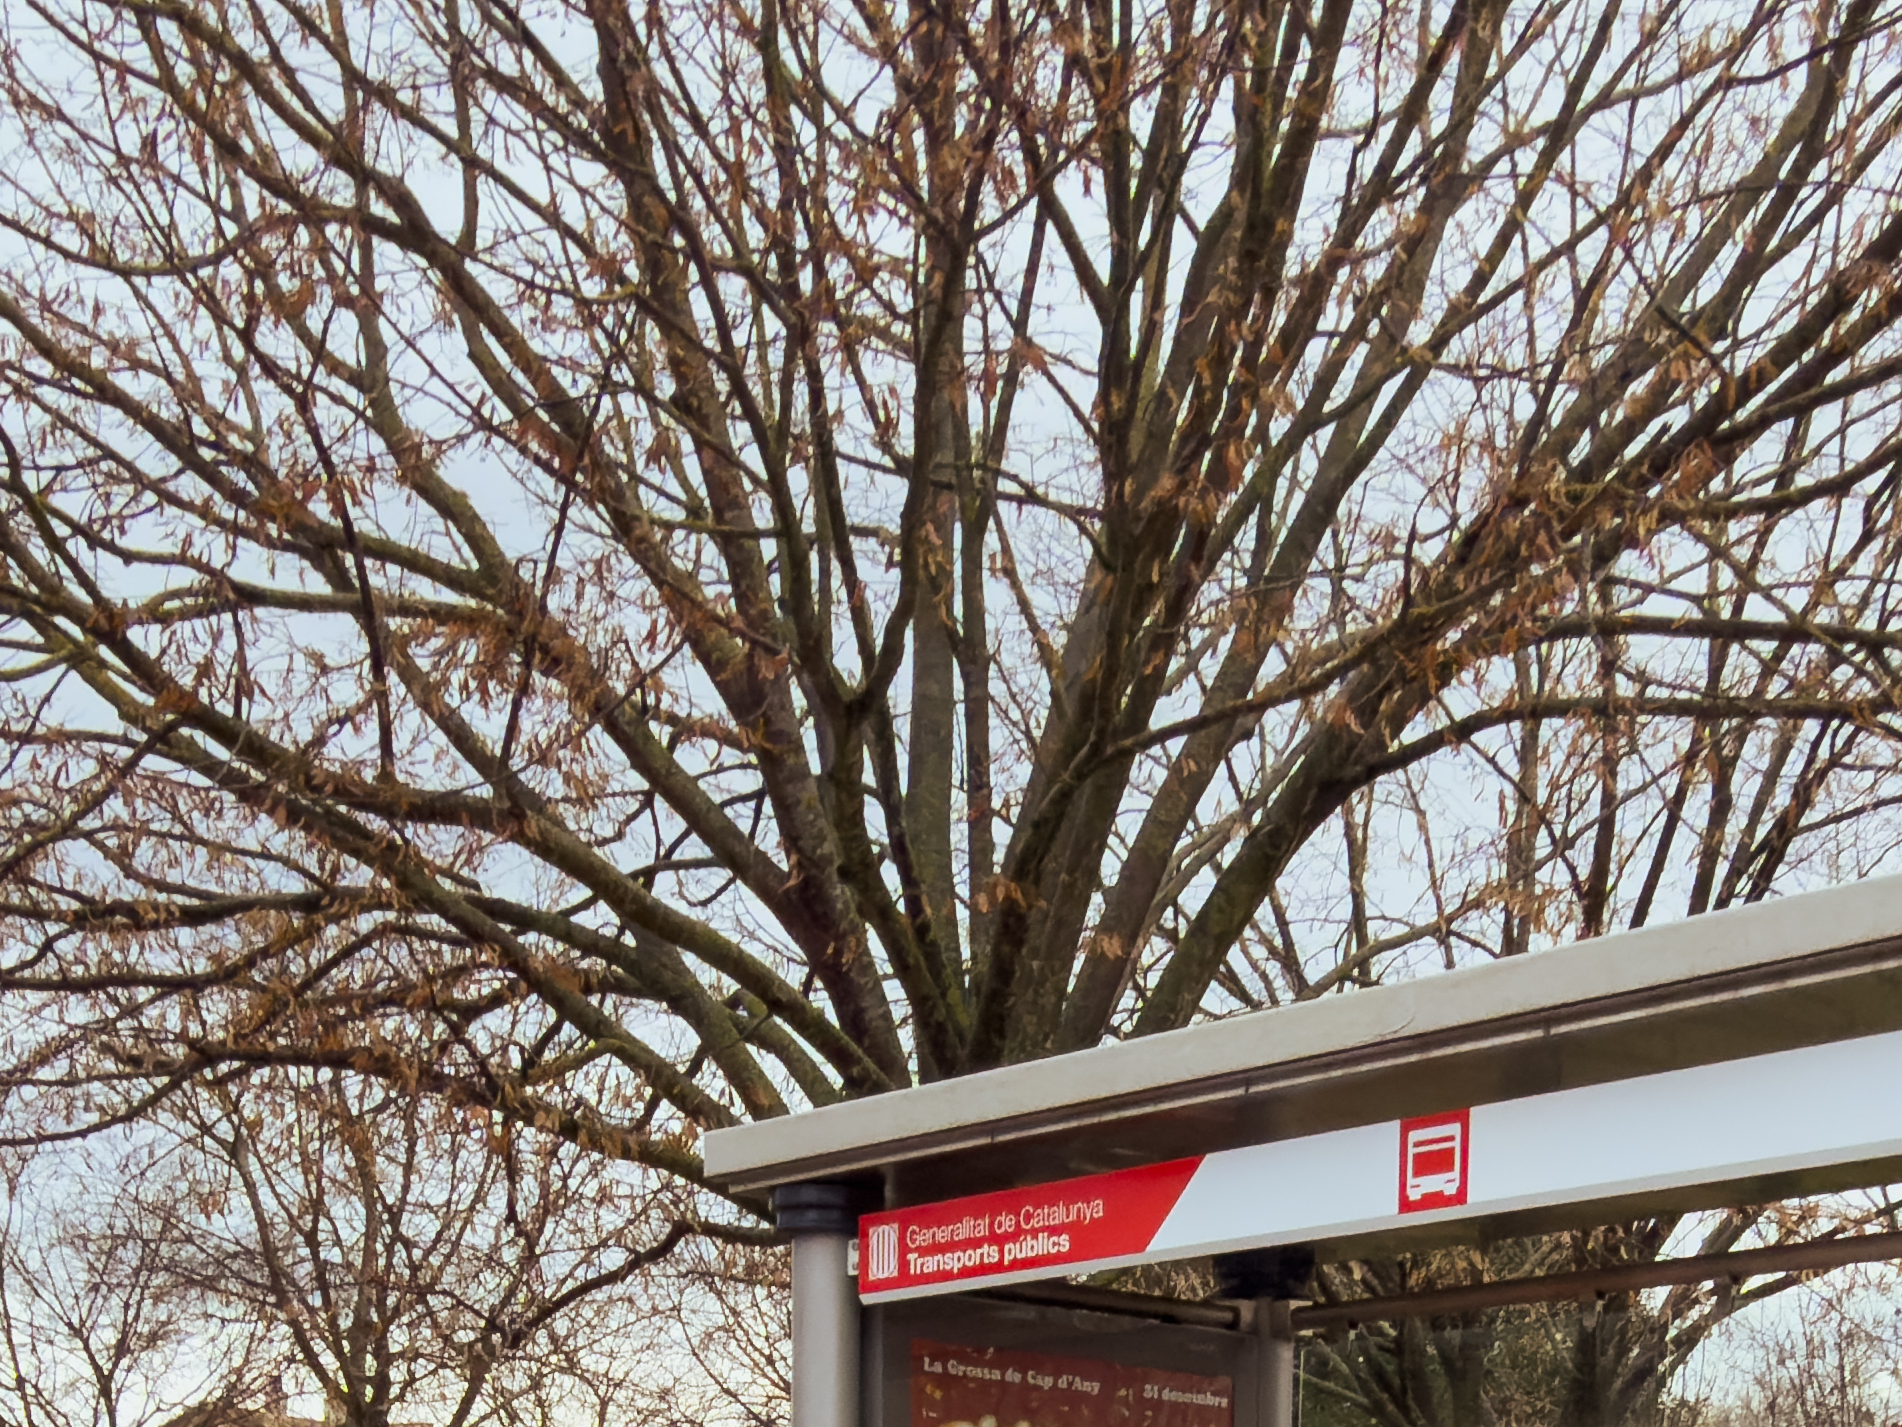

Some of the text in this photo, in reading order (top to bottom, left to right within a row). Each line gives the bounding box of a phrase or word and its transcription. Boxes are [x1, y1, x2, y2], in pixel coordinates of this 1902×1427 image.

[906, 1198, 1105, 1248] Generalitat de Catalunya
[906, 1232, 1071, 1276] Transports públics
[923, 1357, 1101, 1396] La Grossa de Cap d'Any
